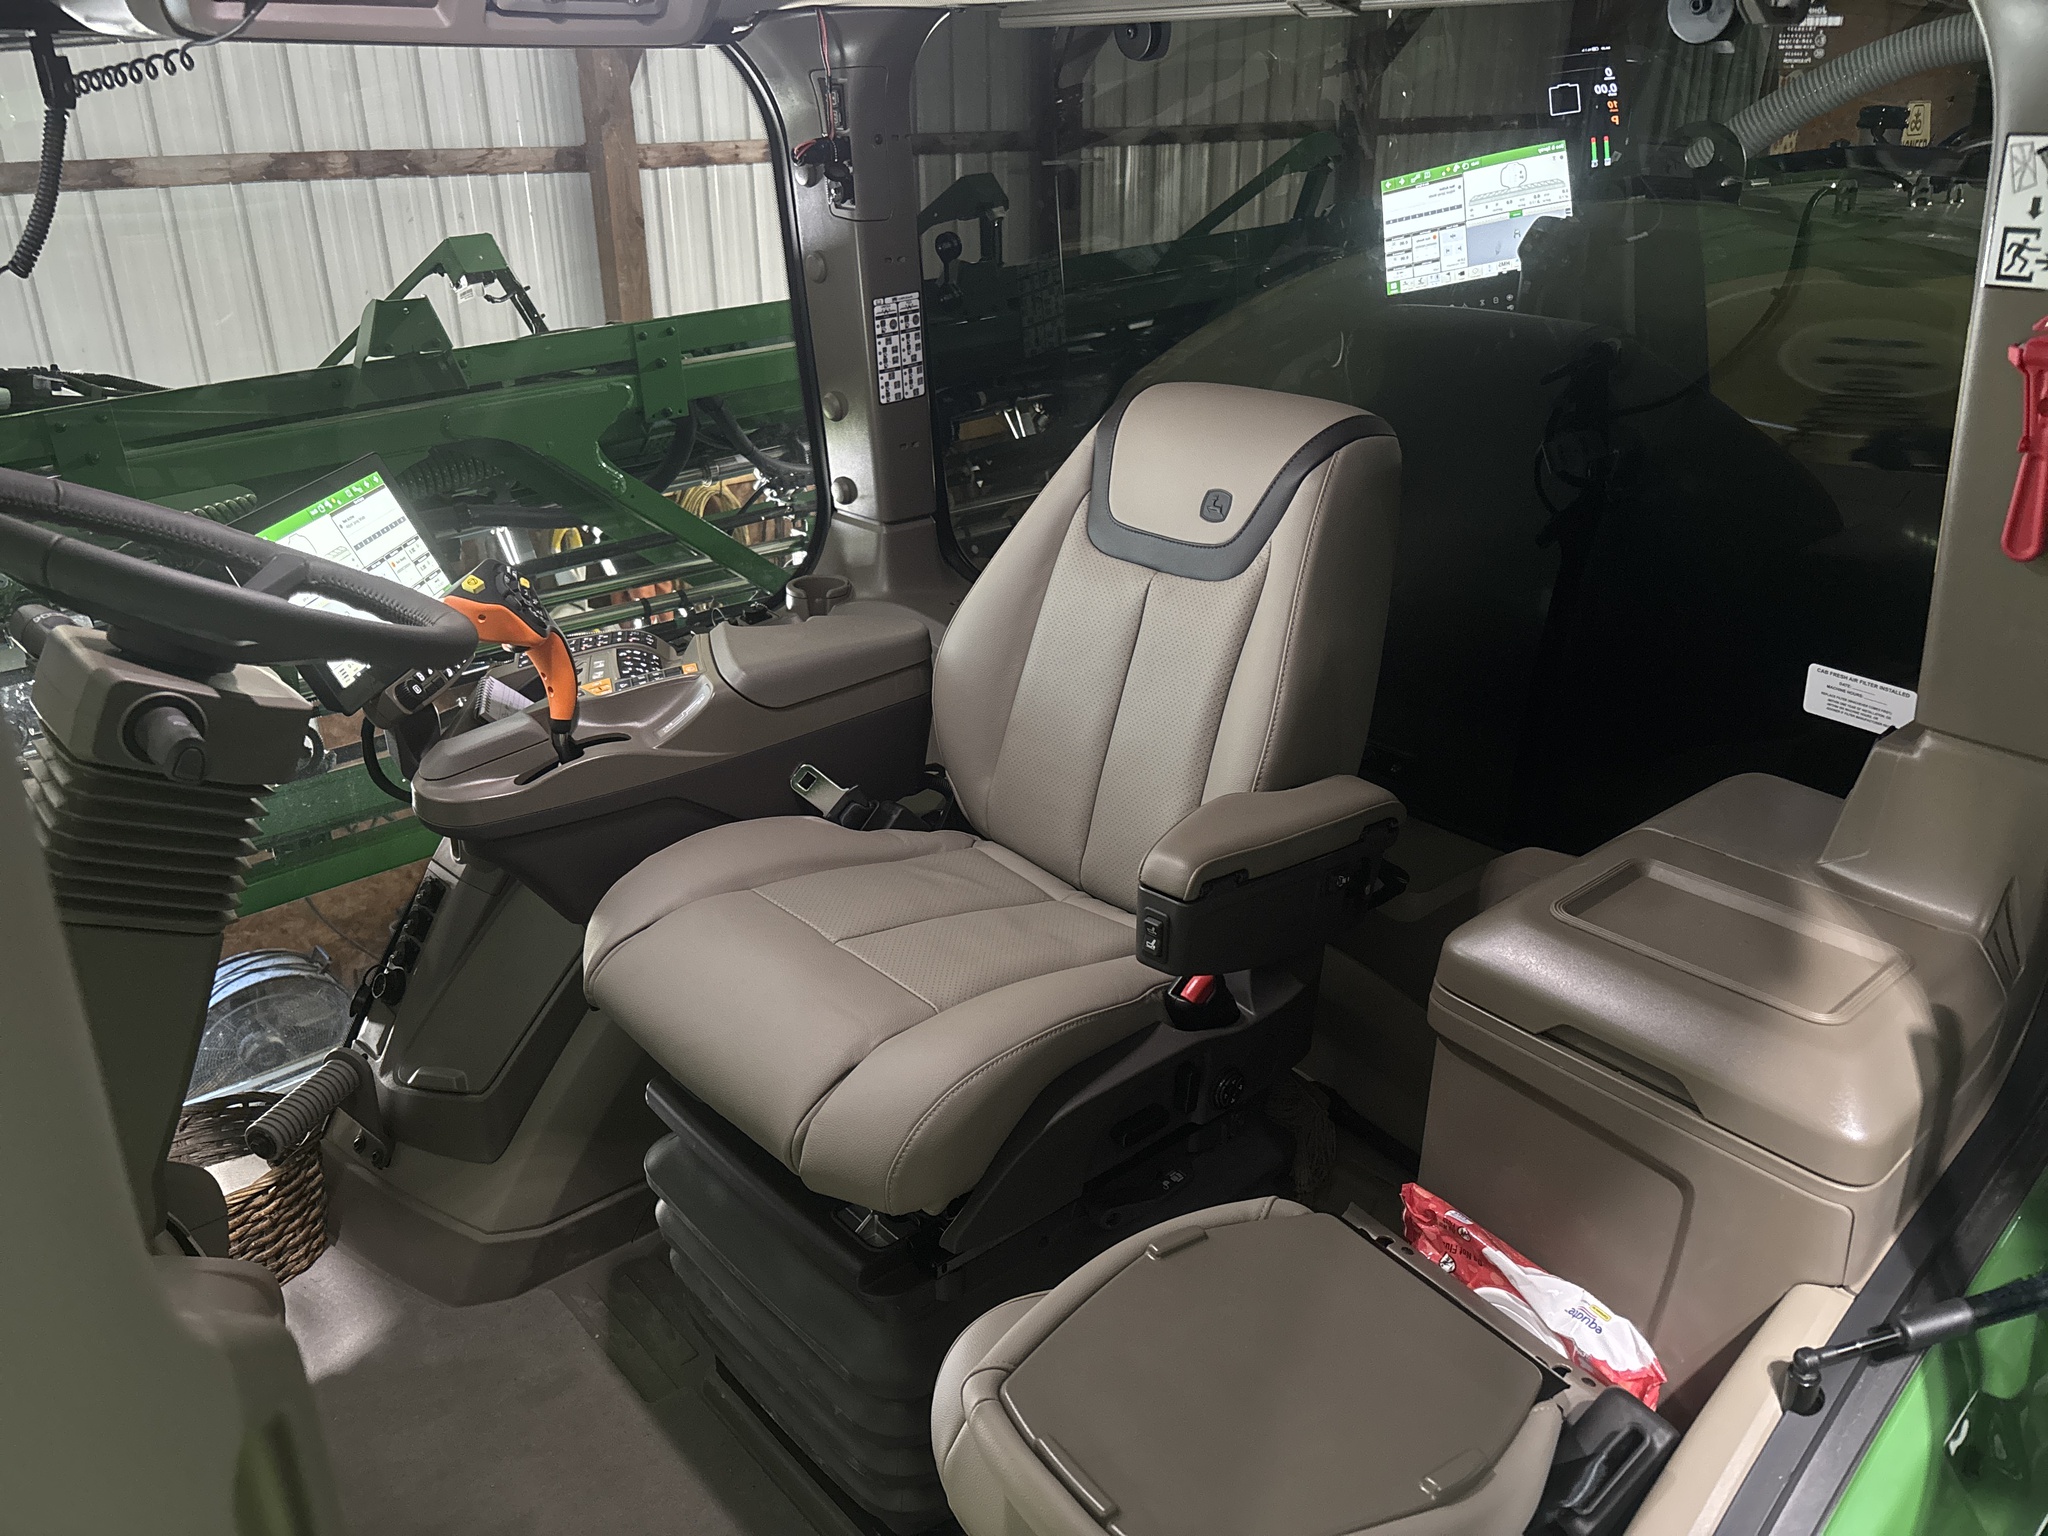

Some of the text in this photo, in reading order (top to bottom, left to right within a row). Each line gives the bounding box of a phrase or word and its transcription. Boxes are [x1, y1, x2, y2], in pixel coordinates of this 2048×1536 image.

[1827, 685, 1846, 693] MACHINE
[1830, 671, 1848, 680] FRESH
[1860, 679, 1879, 689] FILTER
[1879, 685, 1910, 698] INSTALLED
[1442, 1242, 1457, 1254] Flu
[1460, 1247, 1471, 1260] Not
[1568, 1308, 1602, 1334] equate
